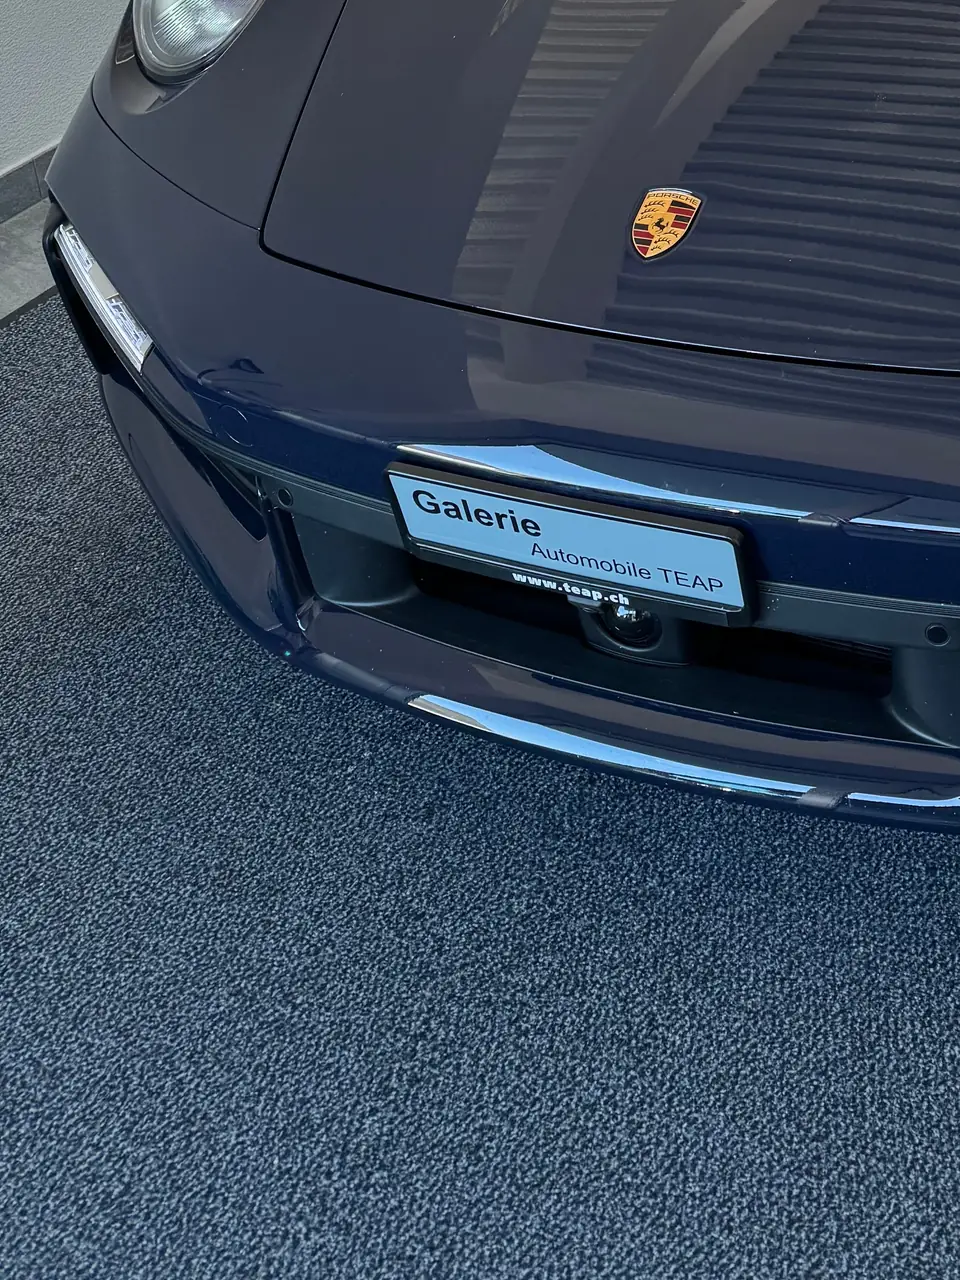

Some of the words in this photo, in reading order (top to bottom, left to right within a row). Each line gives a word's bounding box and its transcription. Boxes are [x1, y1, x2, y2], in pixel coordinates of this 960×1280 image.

[647, 192, 698, 206] PORSCHE
[411, 489, 542, 537] Galerie
[531, 542, 652, 580] Automobile
[657, 568, 723, 593] TEAP
[511, 571, 630, 606] www.teap.ch
